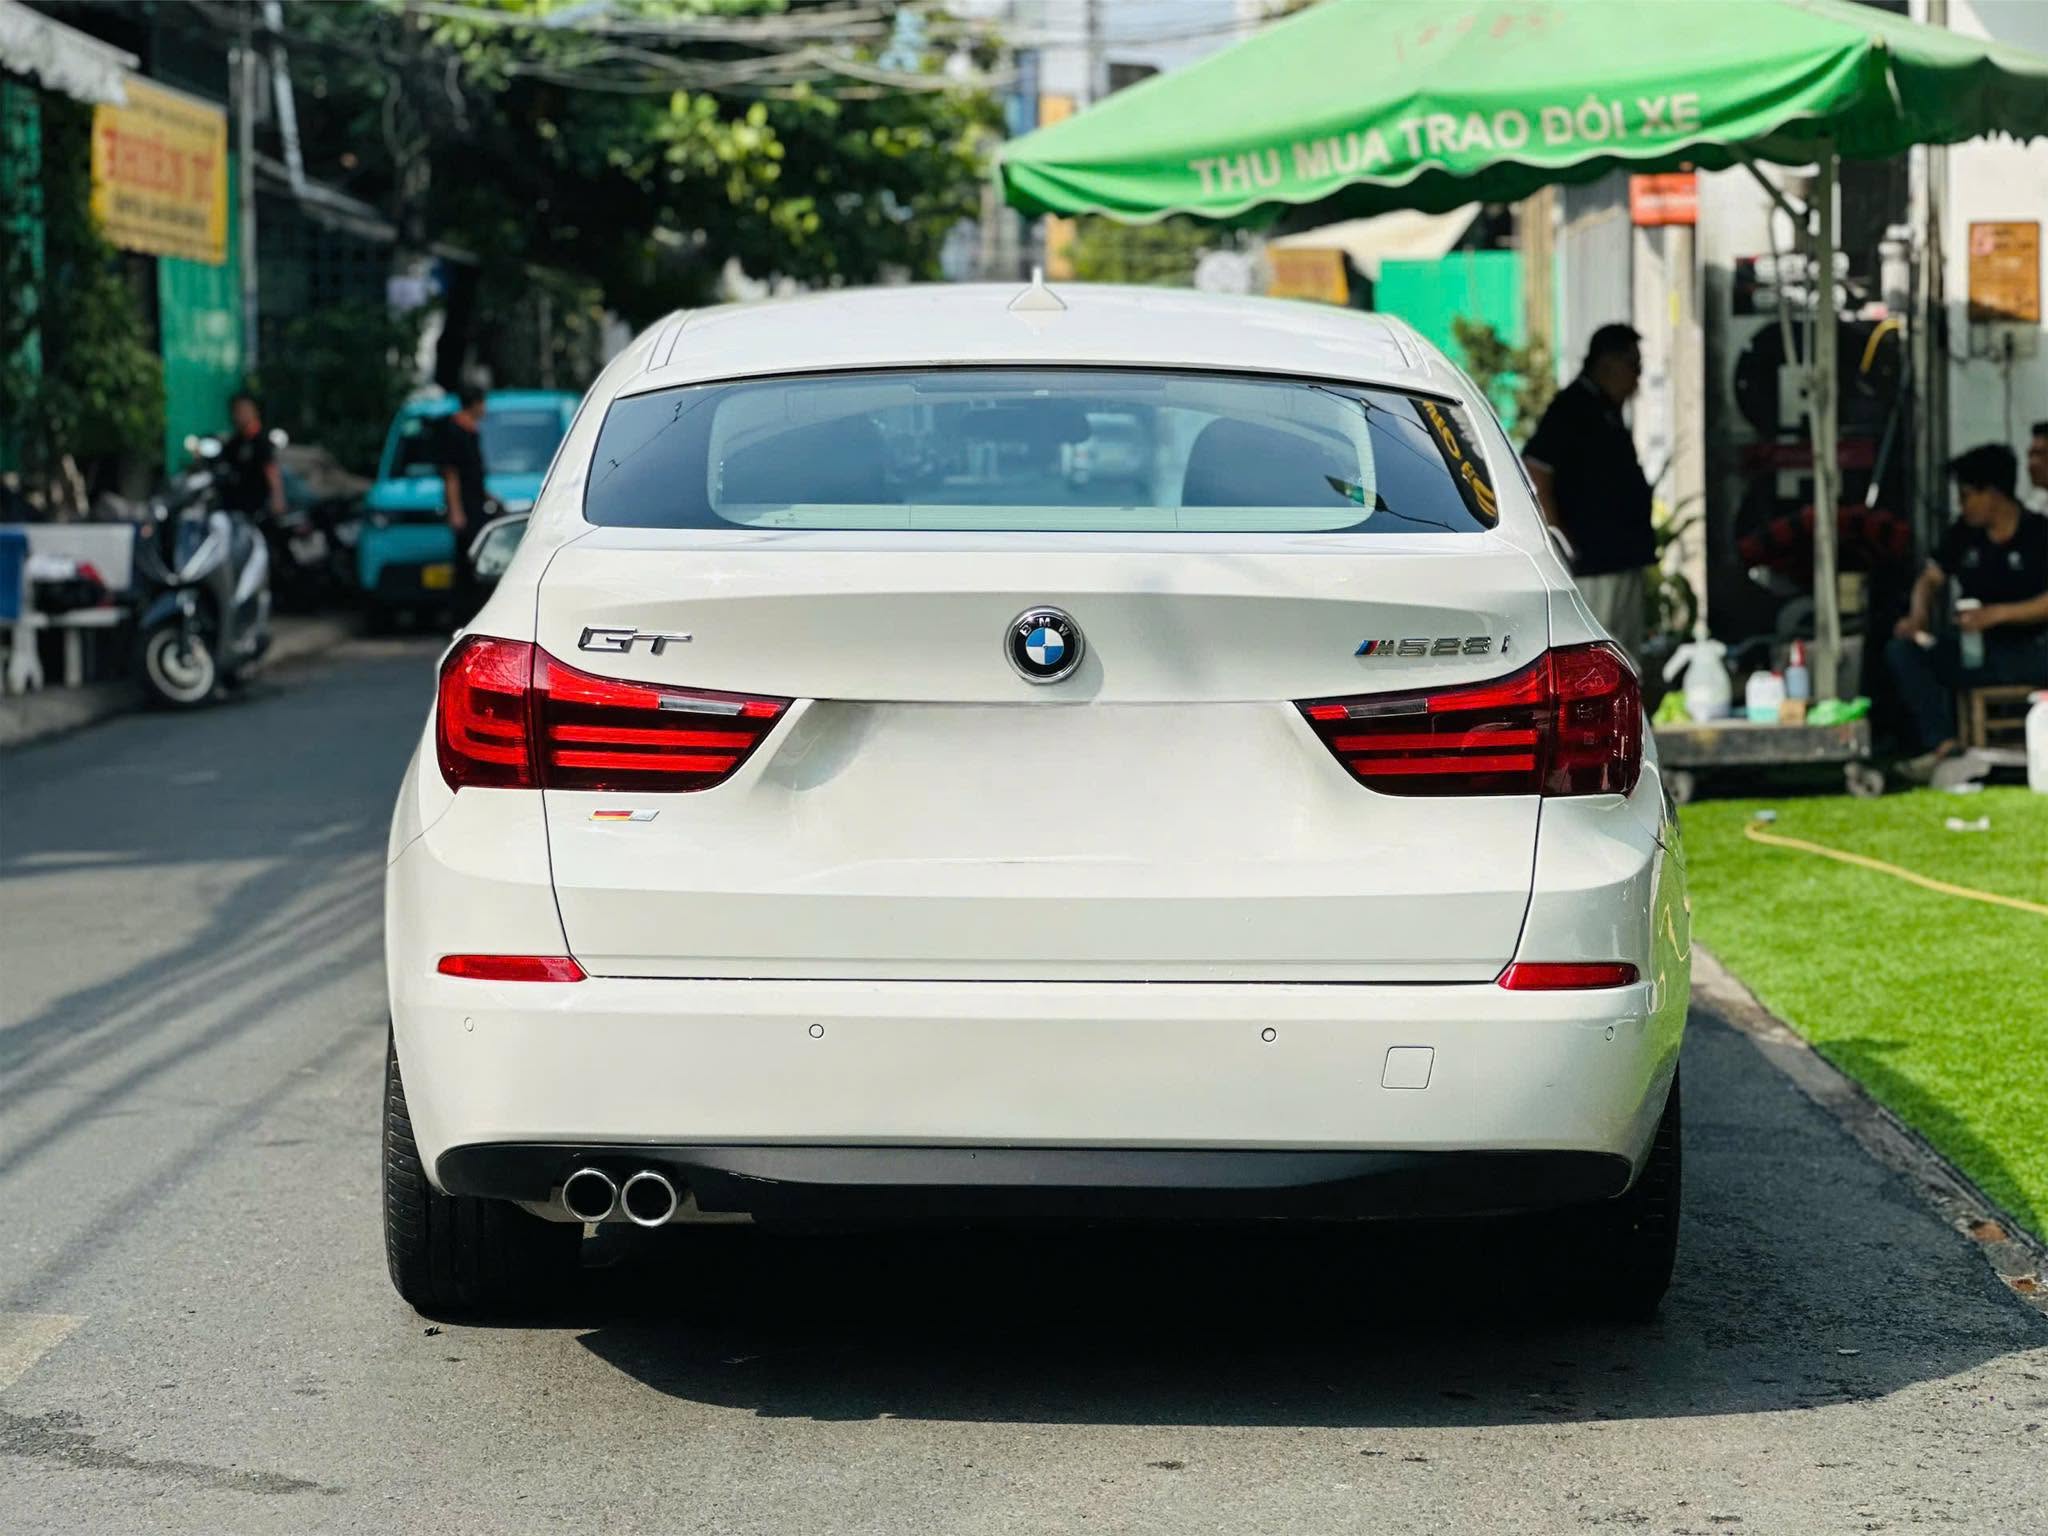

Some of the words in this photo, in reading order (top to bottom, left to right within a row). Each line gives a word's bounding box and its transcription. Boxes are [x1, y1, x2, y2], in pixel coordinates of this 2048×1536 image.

[1190, 149, 1281, 195] THU
[1291, 127, 1392, 180] MUA
[1399, 111, 1529, 159] TRAO
[1637, 92, 1699, 137] XE
[577, 625, 693, 655] GT
[1019, 617, 1071, 637] BMW
